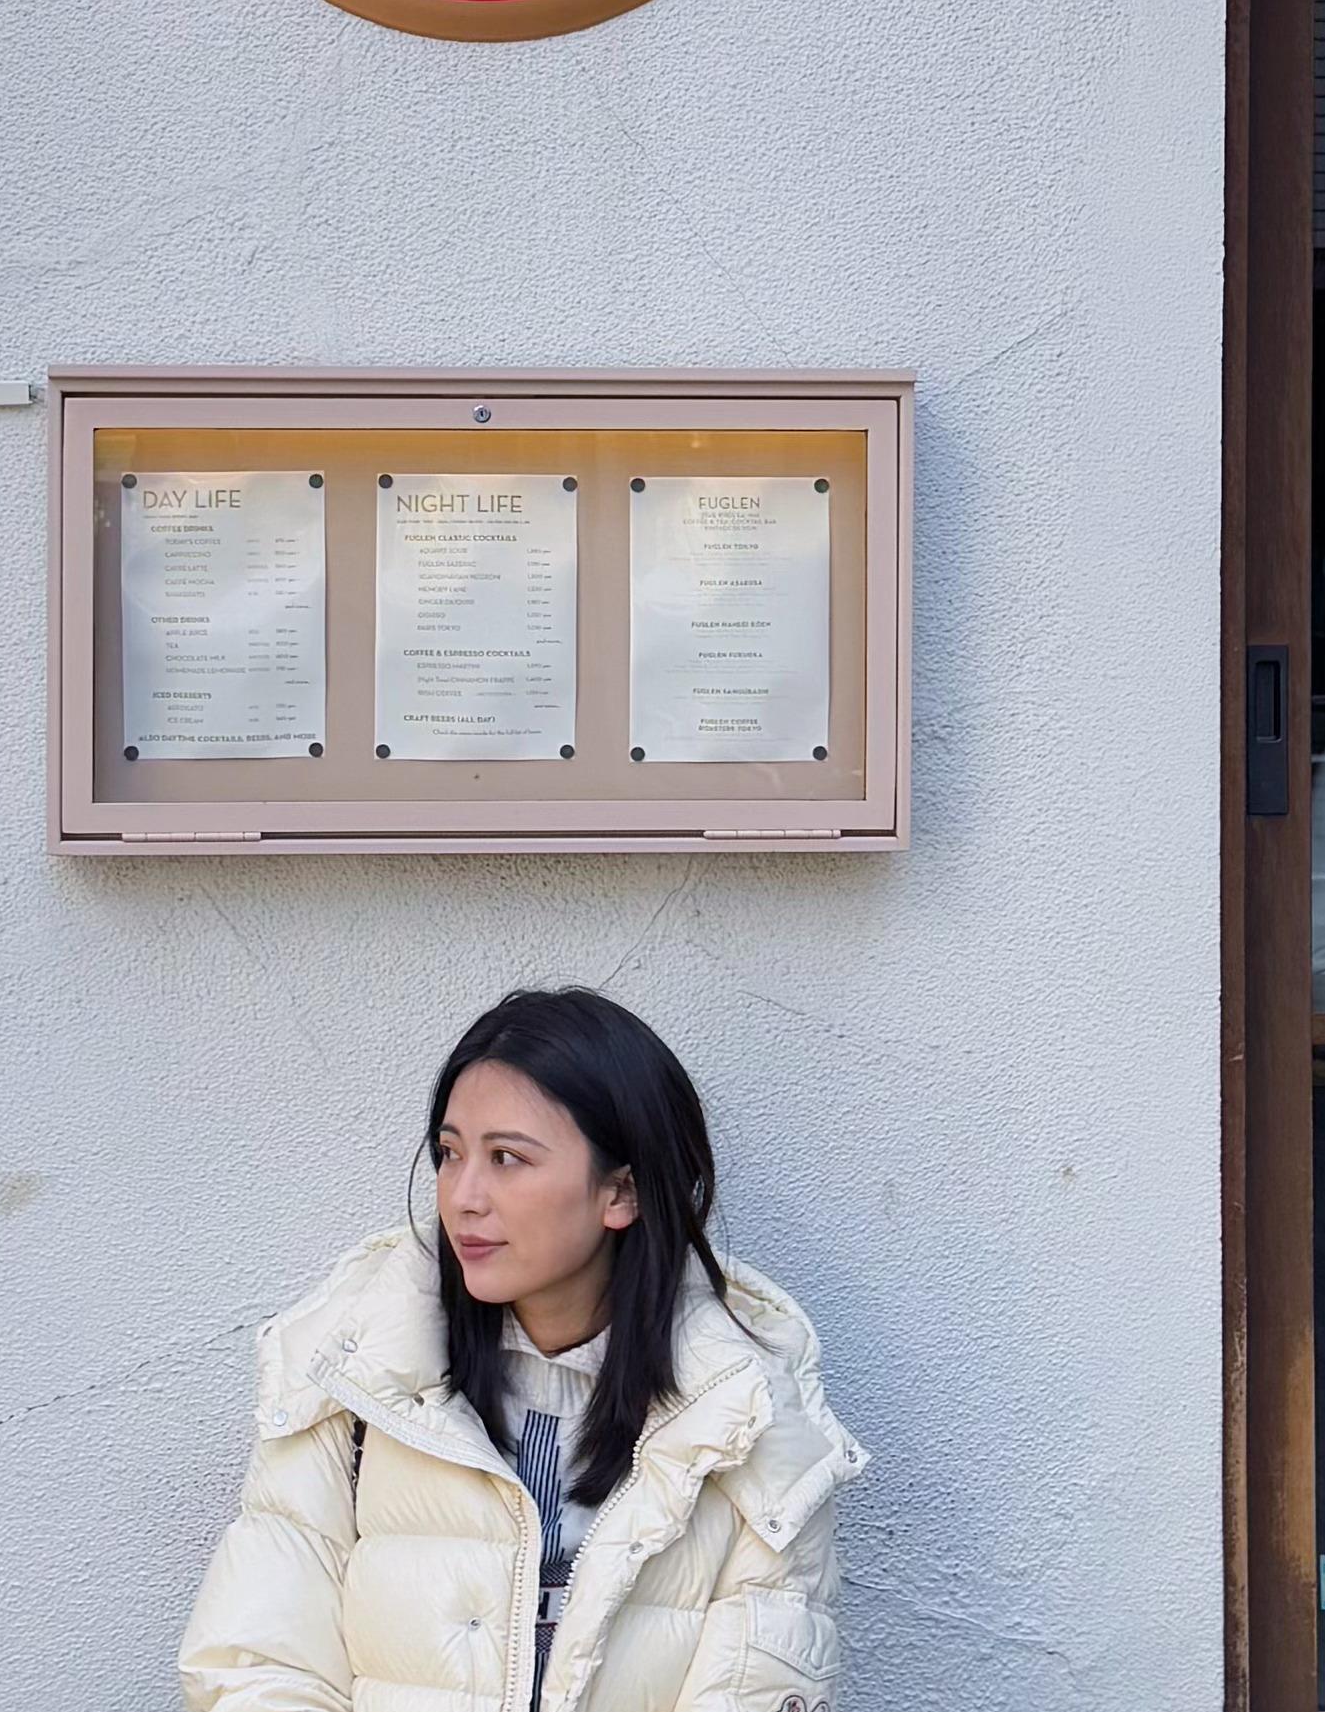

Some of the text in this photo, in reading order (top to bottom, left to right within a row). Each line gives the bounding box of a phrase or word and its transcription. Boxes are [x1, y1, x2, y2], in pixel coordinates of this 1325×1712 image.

[142, 489, 242, 509] DAY LIFE
[396, 494, 523, 514] NIGHT LIFE
[698, 496, 761, 510] FUGLEN
